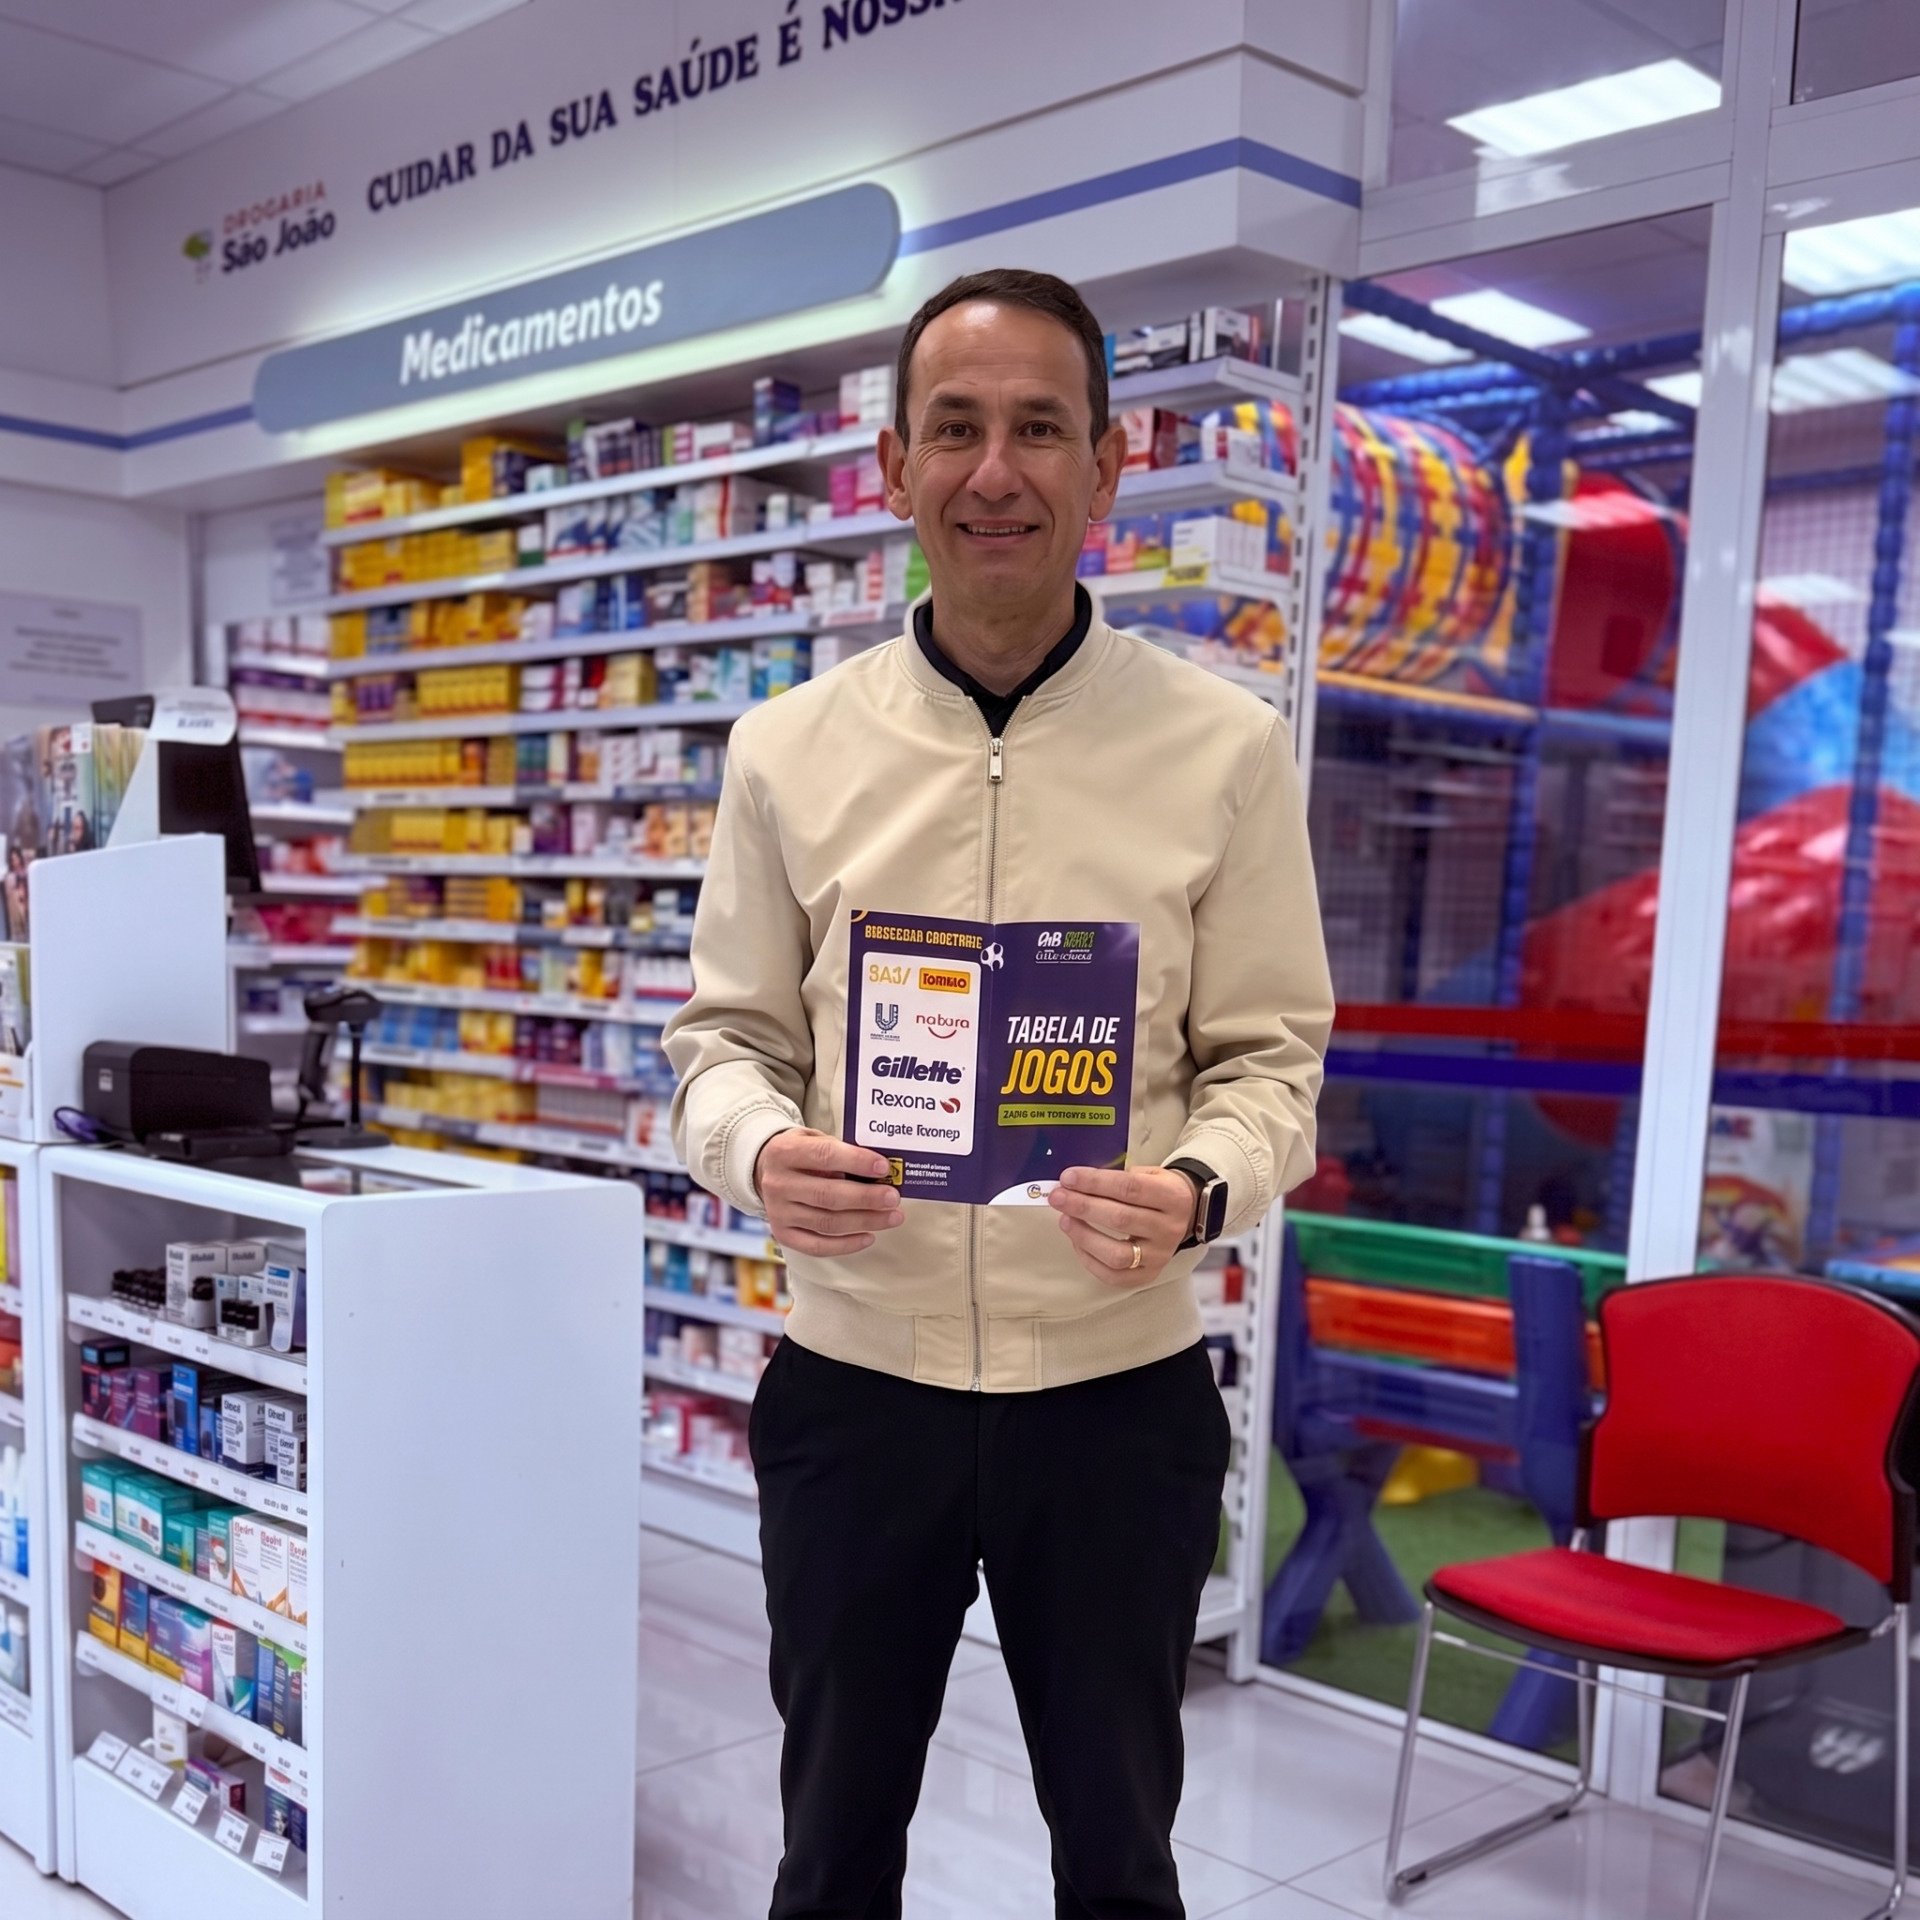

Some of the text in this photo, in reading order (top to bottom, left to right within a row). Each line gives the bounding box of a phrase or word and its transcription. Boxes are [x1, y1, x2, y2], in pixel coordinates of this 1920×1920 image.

[367, 0, 962, 212] CUIDAR DA SUA SAÚDE É NOS
[223, 180, 325, 235] DROGARIA
[222, 206, 335, 273] São João
[401, 280, 664, 385] Medicamentos
[1007, 1016, 1120, 1044] TABELA DE
[871, 1055, 962, 1085] Gillette
[1000, 1049, 1117, 1096] JOGOS
[871, 1088, 936, 1111] Rexona
[869, 1120, 913, 1137] Colgate
